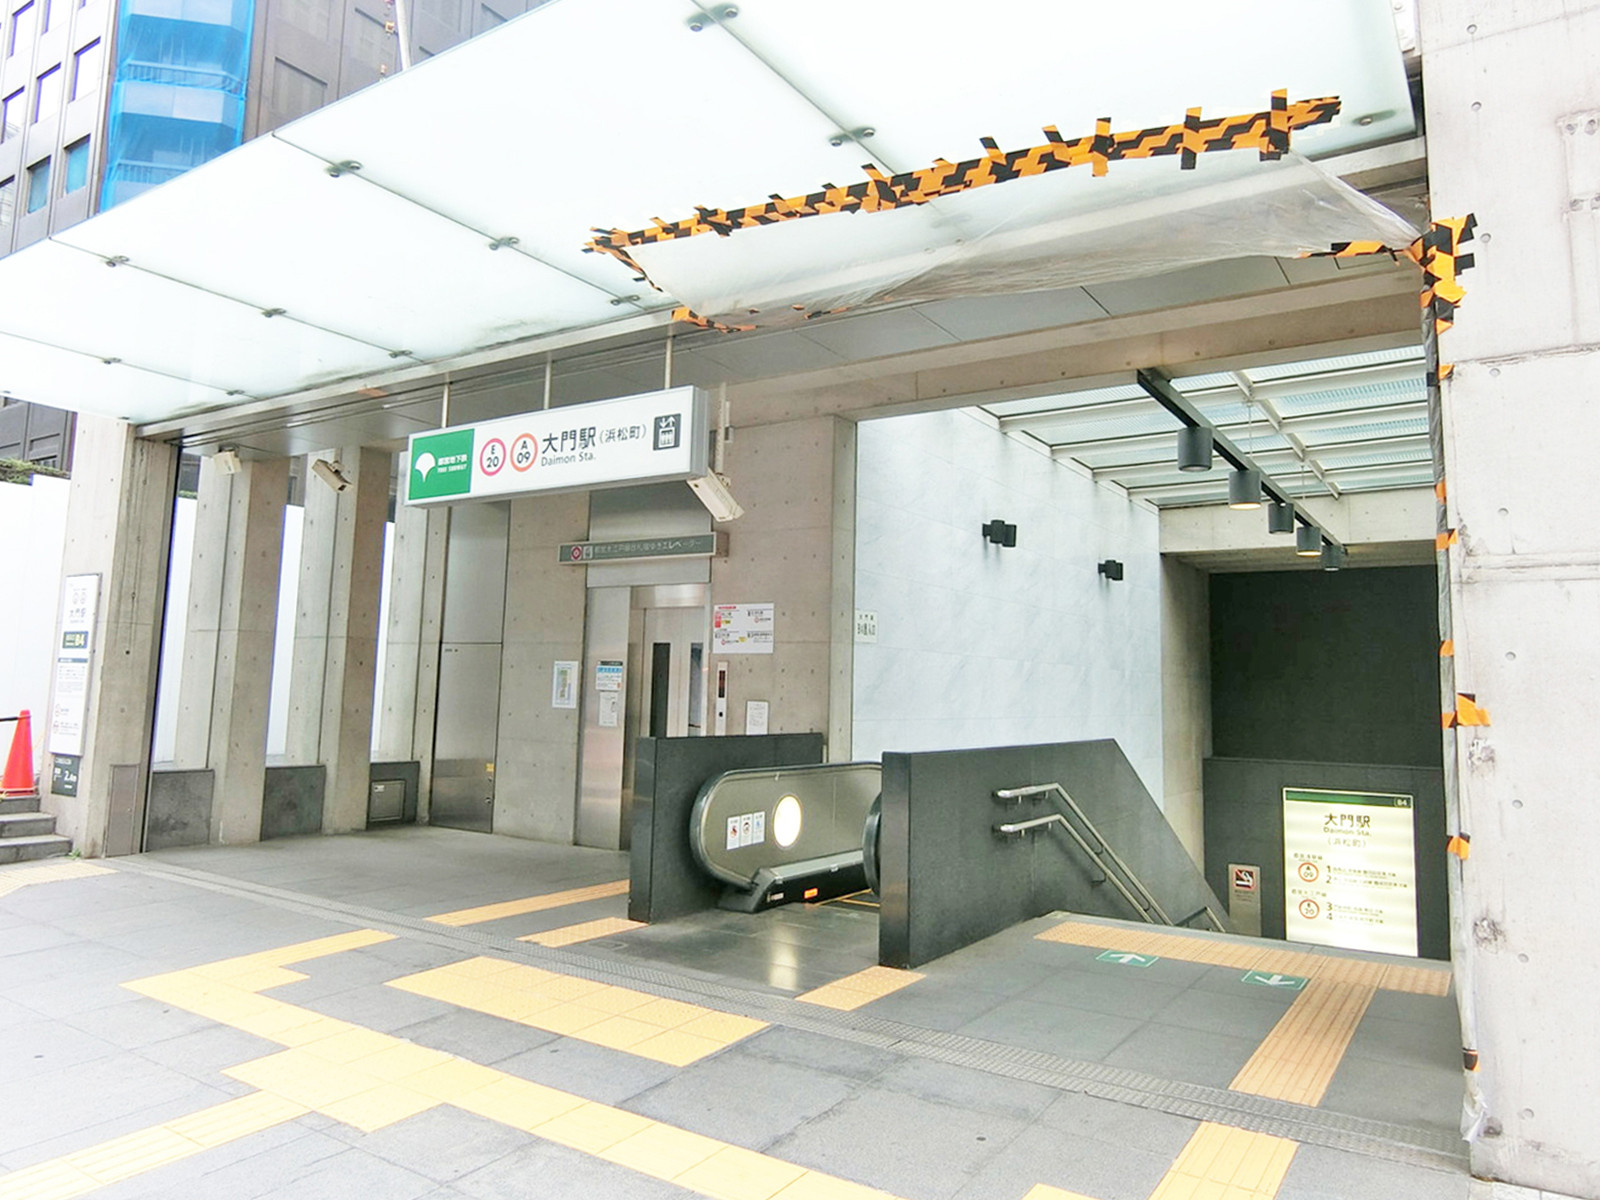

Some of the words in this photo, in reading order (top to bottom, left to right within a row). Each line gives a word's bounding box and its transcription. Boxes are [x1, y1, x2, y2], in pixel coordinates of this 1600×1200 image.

[521, 440, 528, 450] A
[541, 426, 597, 455] 大門駅
[490, 444, 496, 455] E
[486, 456, 500, 468] 20
[516, 451, 531, 464] 09
[541, 452, 576, 467] Daimon
[578, 451, 596, 463] Sta.
[1324, 812, 1371, 828] 大門駅
